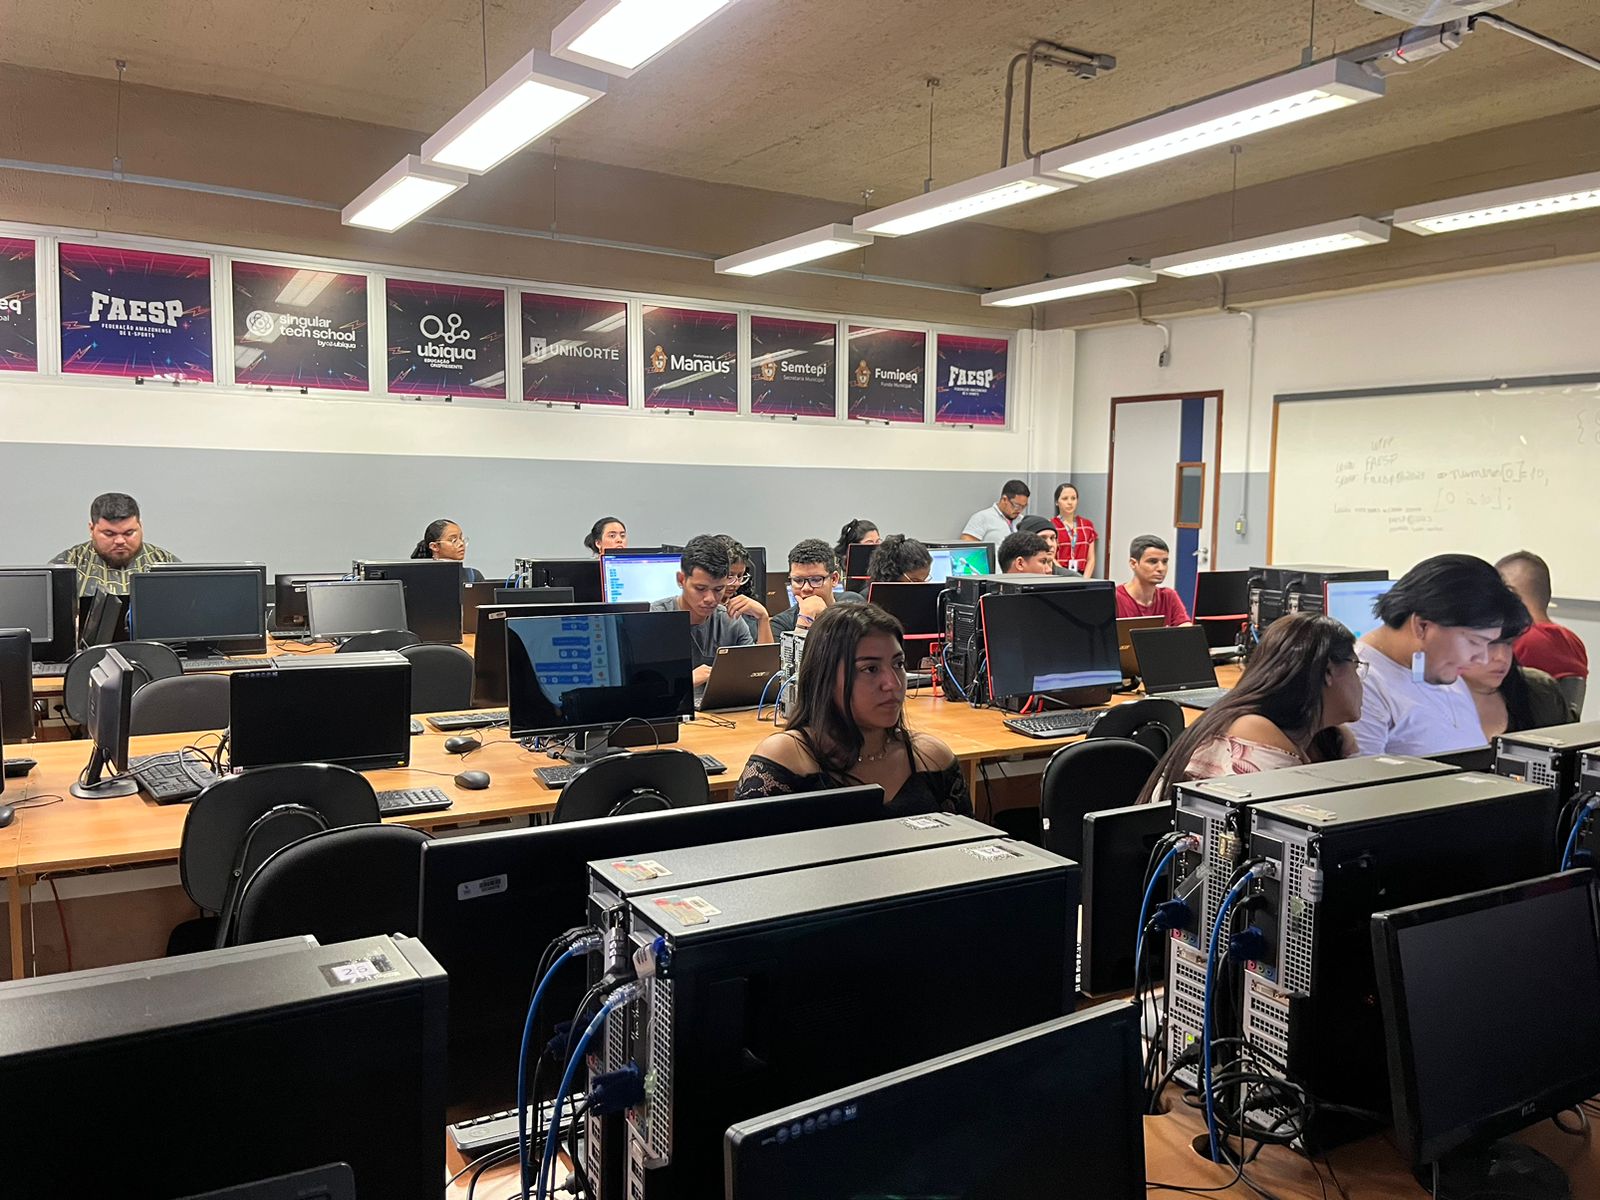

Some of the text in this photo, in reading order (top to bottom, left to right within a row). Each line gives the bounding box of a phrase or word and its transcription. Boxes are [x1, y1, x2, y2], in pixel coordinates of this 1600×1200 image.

[89, 291, 184, 328] FAESP
[101, 322, 172, 334] FEDERAÇÃO AMAZONENSE
[279, 313, 332, 329] singular
[279, 325, 356, 342] tech school
[417, 341, 477, 363] ubíqua
[550, 344, 620, 361] UNINORTE
[670, 354, 730, 374] Manaus
[780, 360, 827, 377] Semtepi
[874, 367, 918, 384] Fumipeq
[948, 365, 994, 389] FAESP
